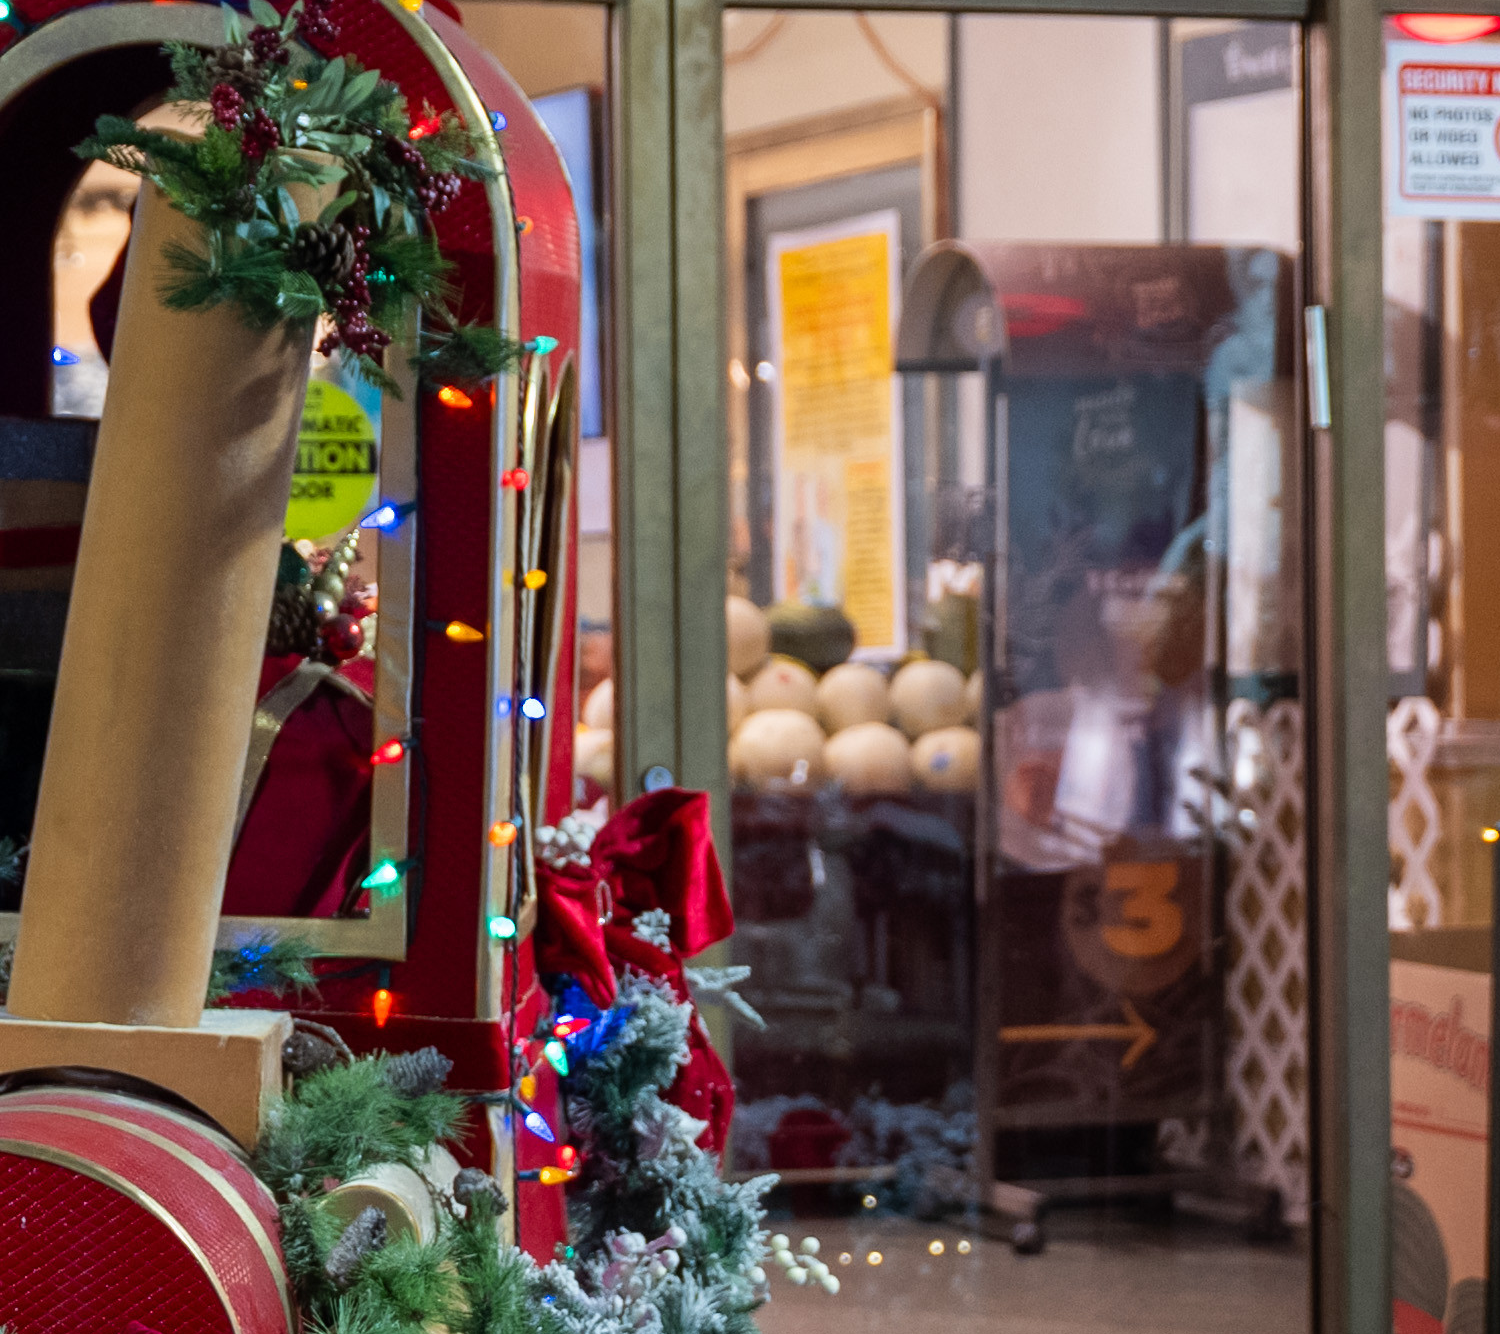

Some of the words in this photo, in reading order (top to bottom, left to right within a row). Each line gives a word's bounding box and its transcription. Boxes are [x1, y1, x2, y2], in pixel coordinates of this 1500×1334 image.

[1403, 69, 1488, 94] SECURITY
[1409, 107, 1428, 120] NO
[1434, 107, 1493, 123] PHOTOS
[1409, 128, 1428, 142] OR
[1437, 128, 1478, 143] VIDEO
[1409, 151, 1480, 166] ALLOWED
[298, 440, 370, 471] TION
